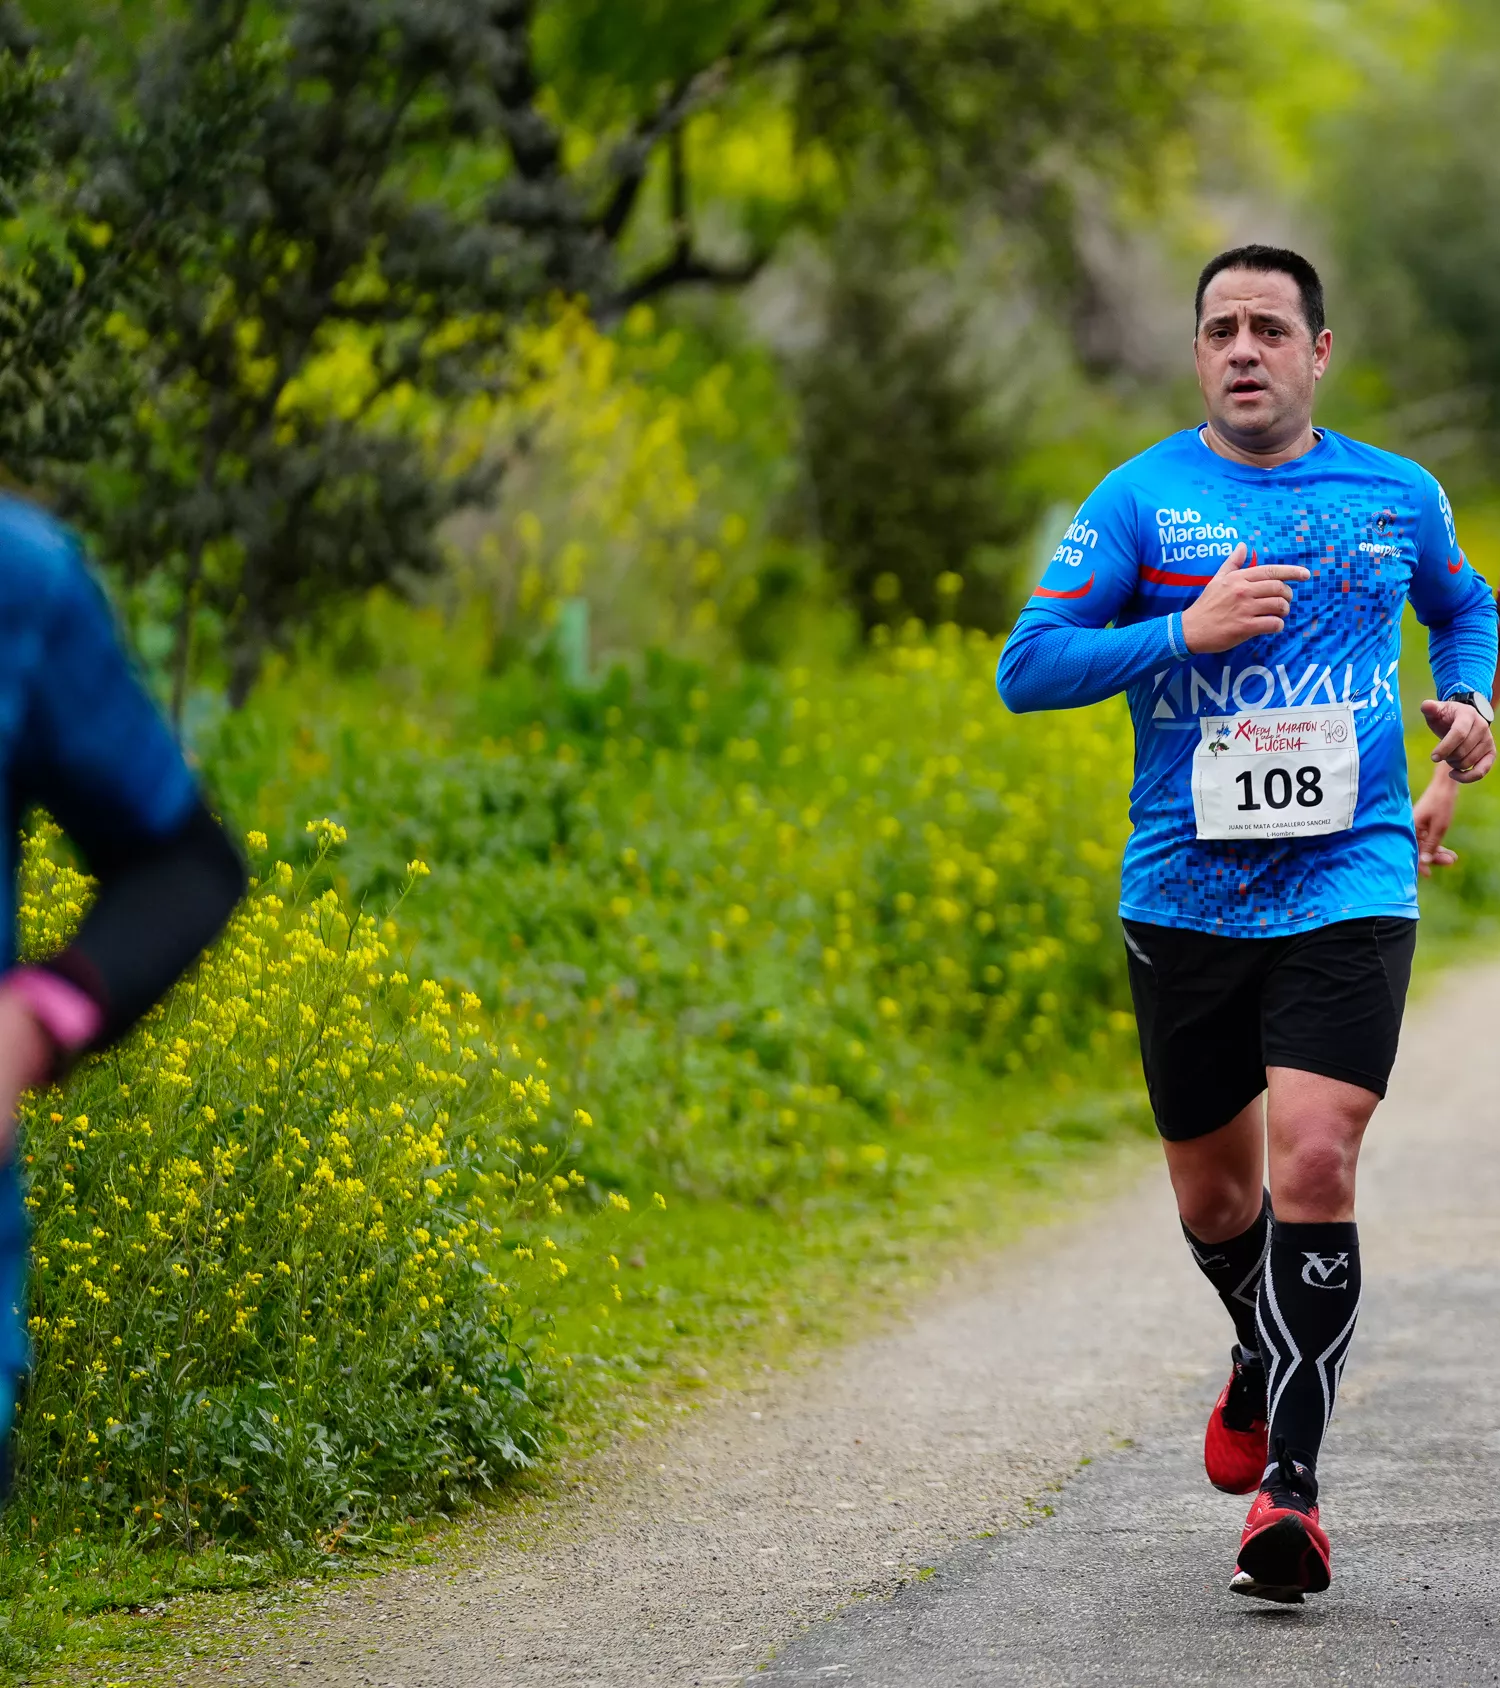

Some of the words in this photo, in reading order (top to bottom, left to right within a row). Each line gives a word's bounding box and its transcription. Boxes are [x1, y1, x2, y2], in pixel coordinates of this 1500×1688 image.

[1155, 507, 1201, 527] Club
[1158, 522, 1239, 546] Maratón
[1161, 542, 1233, 564] Lucena
[1358, 541, 1403, 558] enerplus
[1276, 720, 1317, 735] MARATÓN
[1255, 736, 1308, 753] LUCENA
[1235, 766, 1324, 811] 108
[1253, 822, 1271, 830] MATA
[1271, 820, 1306, 829] CABALLERO
[1306, 818, 1332, 827] SANCHEZ
